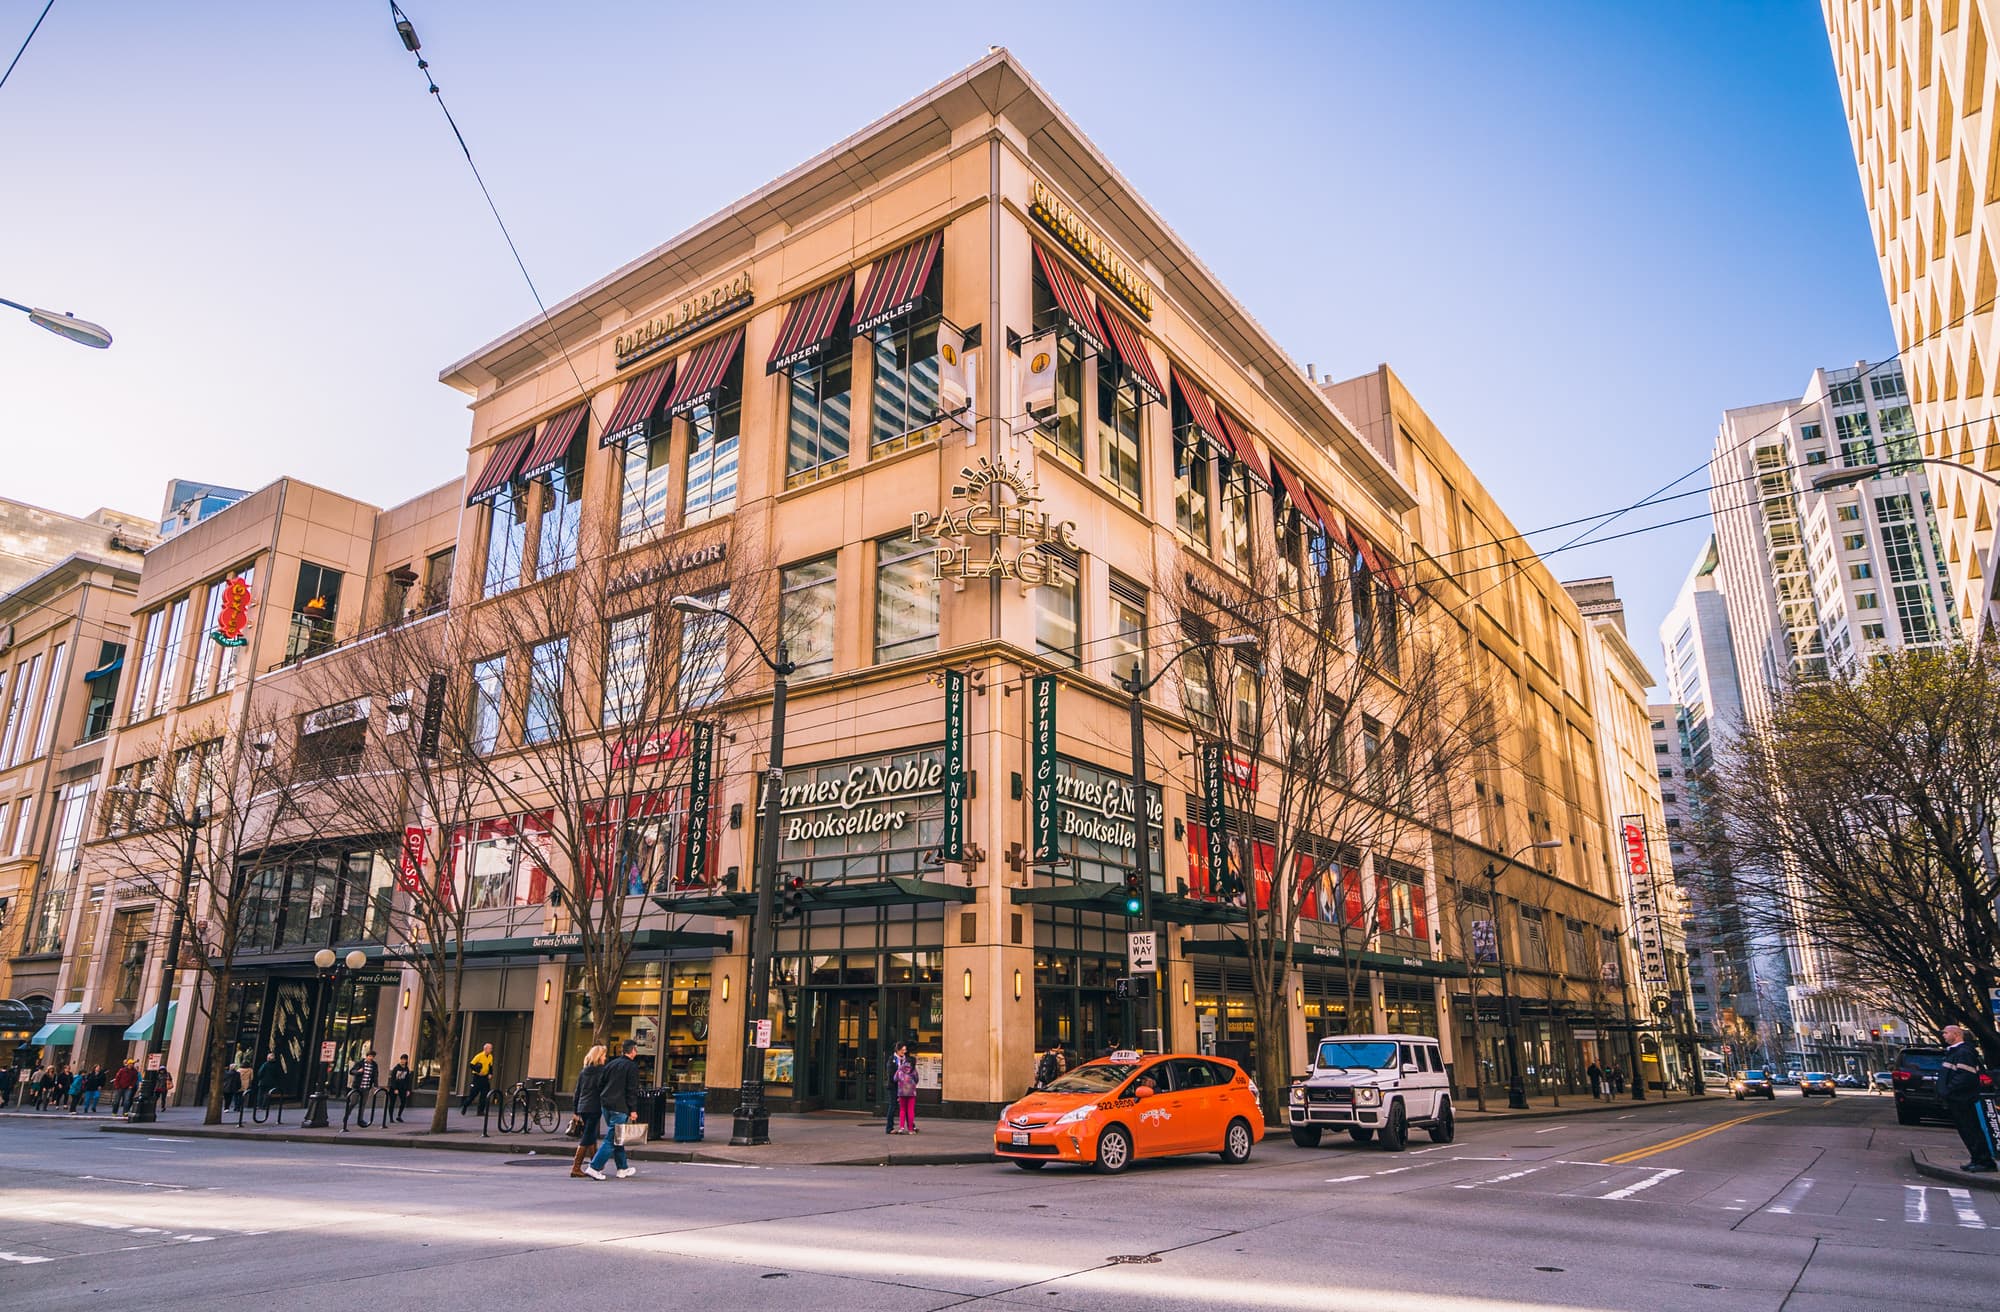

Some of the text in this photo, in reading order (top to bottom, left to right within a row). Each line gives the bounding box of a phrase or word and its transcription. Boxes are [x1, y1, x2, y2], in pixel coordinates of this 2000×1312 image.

[680, 270, 751, 324] Biersch
[856, 301, 913, 334] DUNKLES
[1068, 317, 1104, 353] PILSNER
[775, 343, 820, 369] MARZEN
[1131, 370, 1161, 400] MARZEN
[671, 391, 711, 416] PILSNER
[603, 421, 644, 445] DUNKLES
[524, 460, 556, 481] MARZEN
[471, 485, 502, 504] PILSNER
[910, 504, 1080, 551] PACIFIC
[932, 546, 1064, 588] PLACE
[950, 677, 960, 855] Barnes & Noble
[1037, 681, 1052, 858] Barnes & Noble
[840, 765, 867, 810] &
[867, 757, 943, 796] Noble
[1056, 774, 1163, 821] arnes & Nle
[690, 727, 709, 879] Barnes & Noble
[1208, 747, 1223, 891] Barnes & Noble
[787, 808, 906, 841] Booksellers
[1064, 810, 1136, 849] Bookseller
[1626, 825, 1660, 974] amc THEATRES
[533, 935, 579, 947] Barnes & Noble
[1133, 936, 1151, 945] ONE
[1133, 946, 1152, 955] WAY
[374, 973, 380, 982] &
[1657, 1000, 1667, 1013] P
